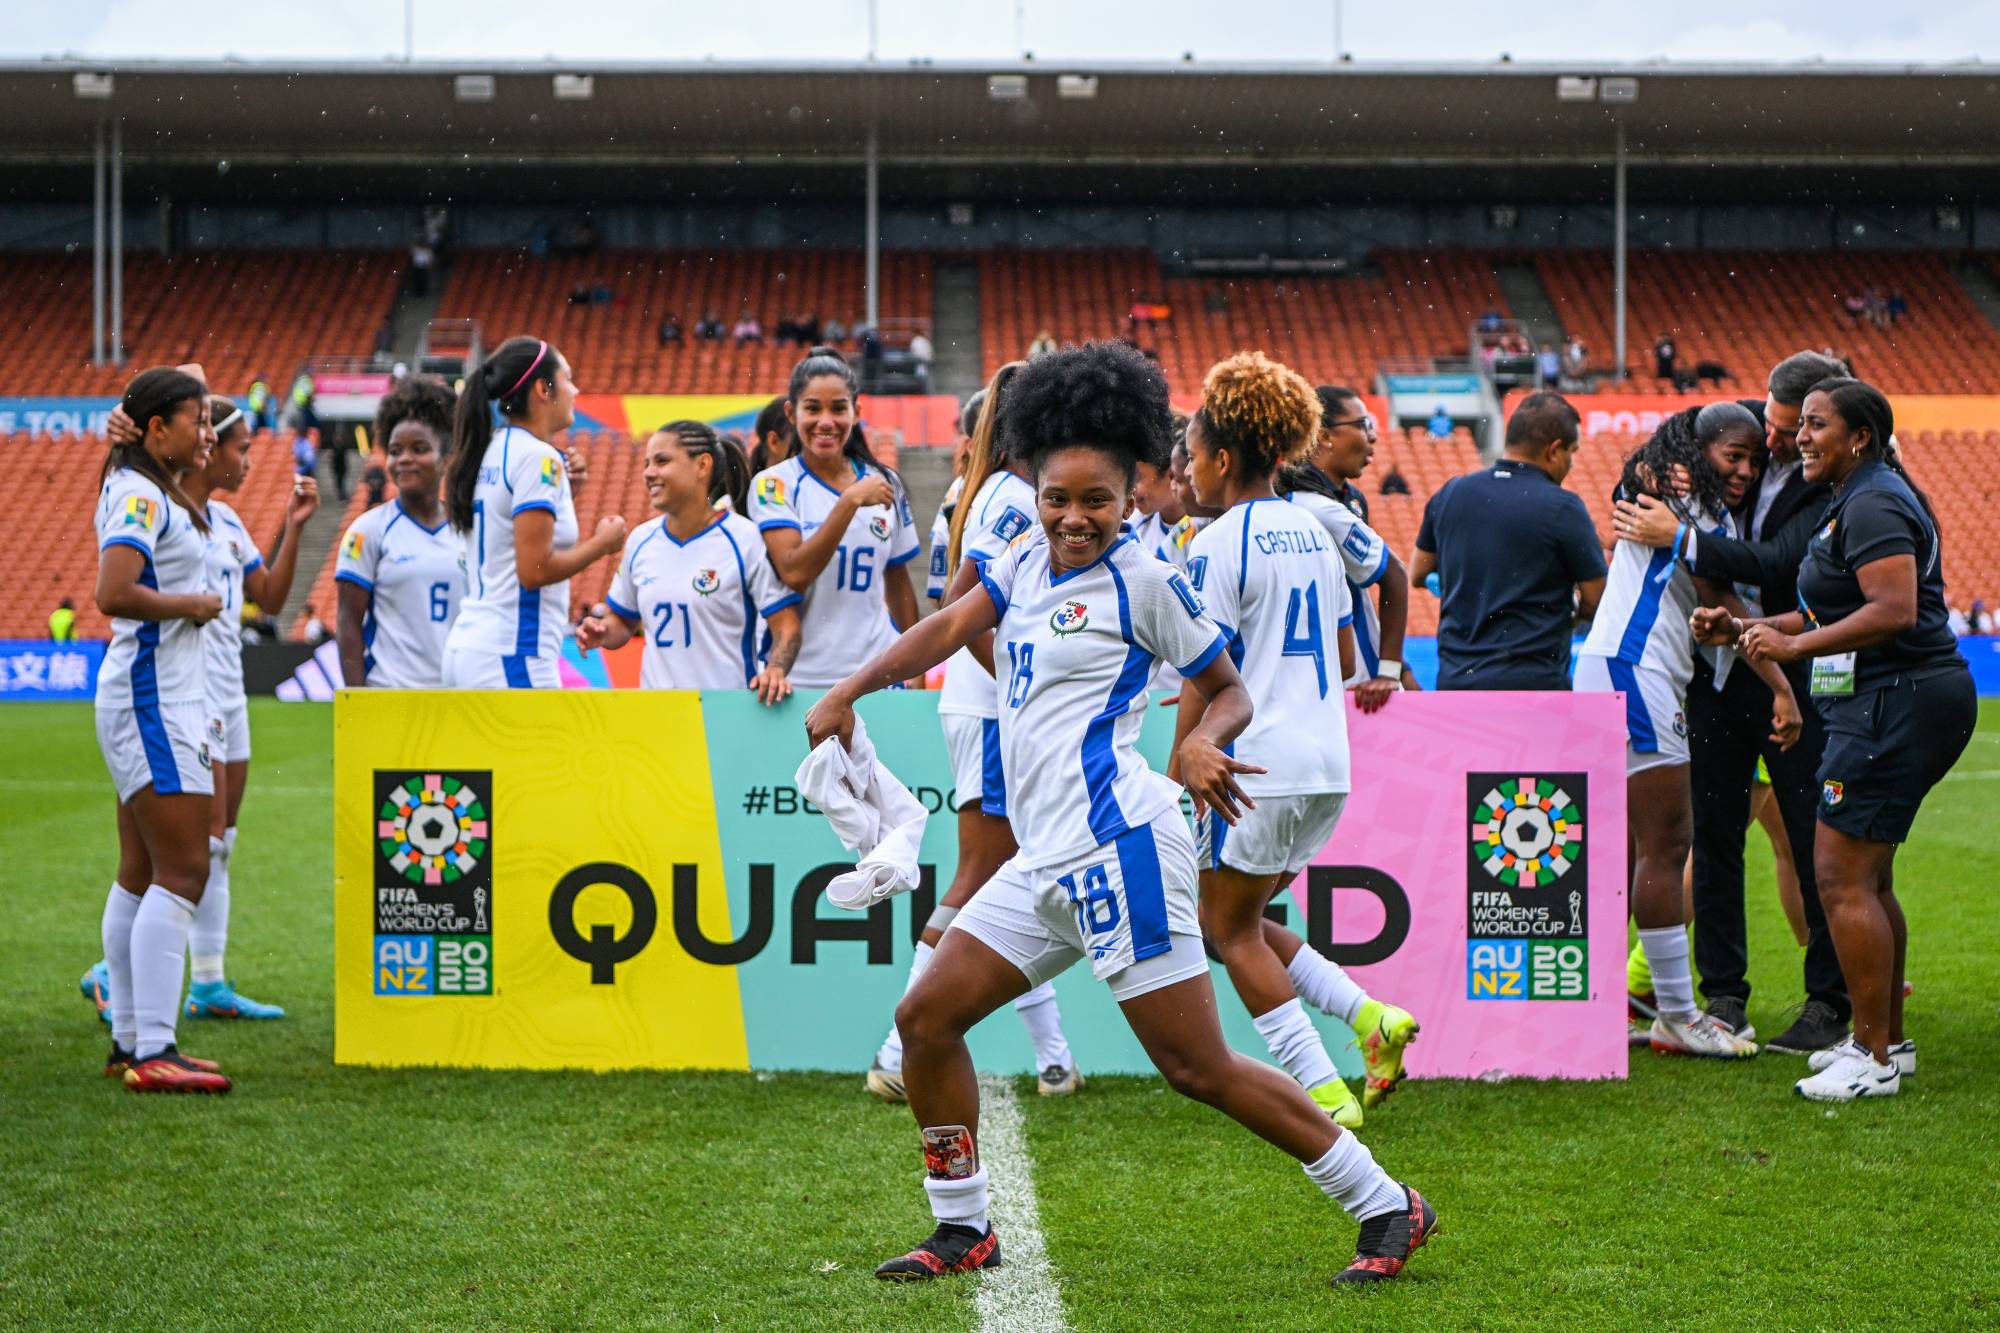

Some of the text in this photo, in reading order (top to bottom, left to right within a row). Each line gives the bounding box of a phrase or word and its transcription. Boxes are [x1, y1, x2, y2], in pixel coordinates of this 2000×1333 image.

[837, 545, 875, 592] 16
[430, 581, 450, 622] 6
[653, 601, 692, 649] 21
[1281, 578, 1329, 701] 4
[1006, 641, 1035, 708] 18
[379, 888, 418, 903] FIFA
[1057, 863, 1122, 936] 18
[1472, 892, 1512, 906] FIFA
[379, 903, 455, 917] WOMEN'S
[1473, 907, 1549, 921] WOMEN'S
[379, 917, 471, 931] WORLD CUP
[1473, 921, 1565, 935] WORLD CUP
[380, 941, 488, 966] AU 20
[1473, 945, 1584, 970] AU 20
[380, 966, 488, 991] NZ 23
[1473, 971, 1584, 996] NZ 23
